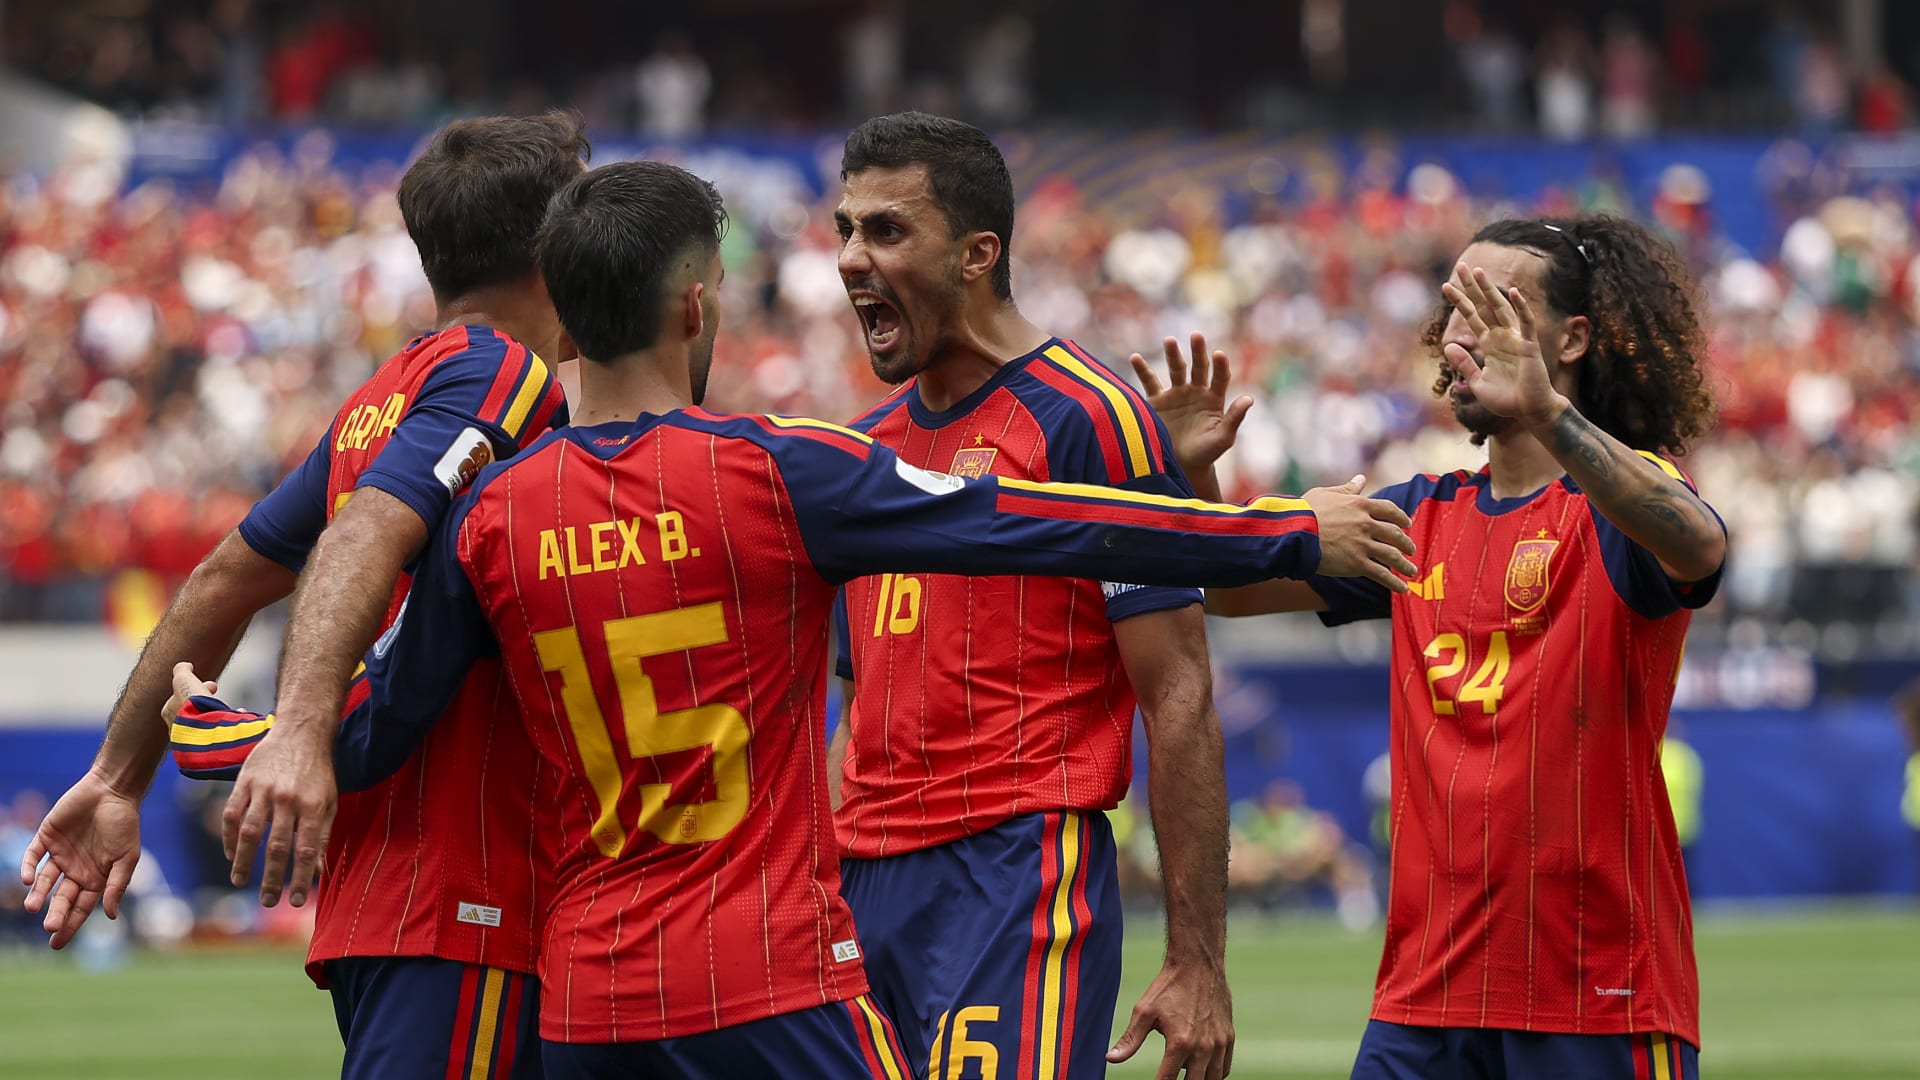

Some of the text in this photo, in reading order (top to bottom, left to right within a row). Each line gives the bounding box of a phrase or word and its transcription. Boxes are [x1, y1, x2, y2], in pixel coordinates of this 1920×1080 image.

[539, 511, 701, 580] ALEX B.
[874, 574, 921, 637] 16
[1424, 631, 1510, 714] 24
[533, 601, 750, 859] 15
